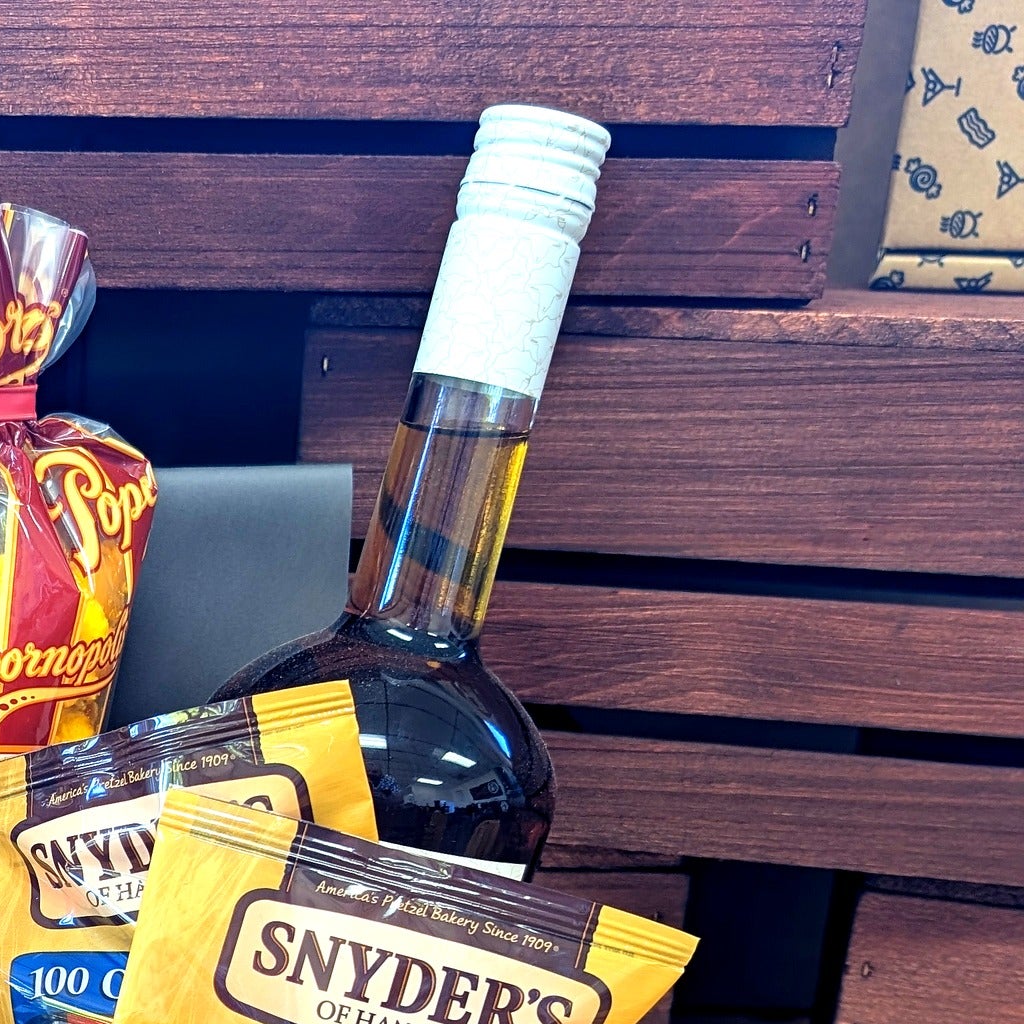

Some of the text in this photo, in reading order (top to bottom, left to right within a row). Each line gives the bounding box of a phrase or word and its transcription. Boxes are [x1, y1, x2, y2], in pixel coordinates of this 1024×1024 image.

[48, 783, 88, 806] America's
[127, 767, 162, 783] Bakery
[201, 753, 229, 769] 1909
[430, 911, 479, 934] Bakery
[482, 921, 518, 943] Since
[523, 933, 553, 953] 1909
[30, 966, 89, 1000] 100
[316, 1000, 350, 1024] OF
